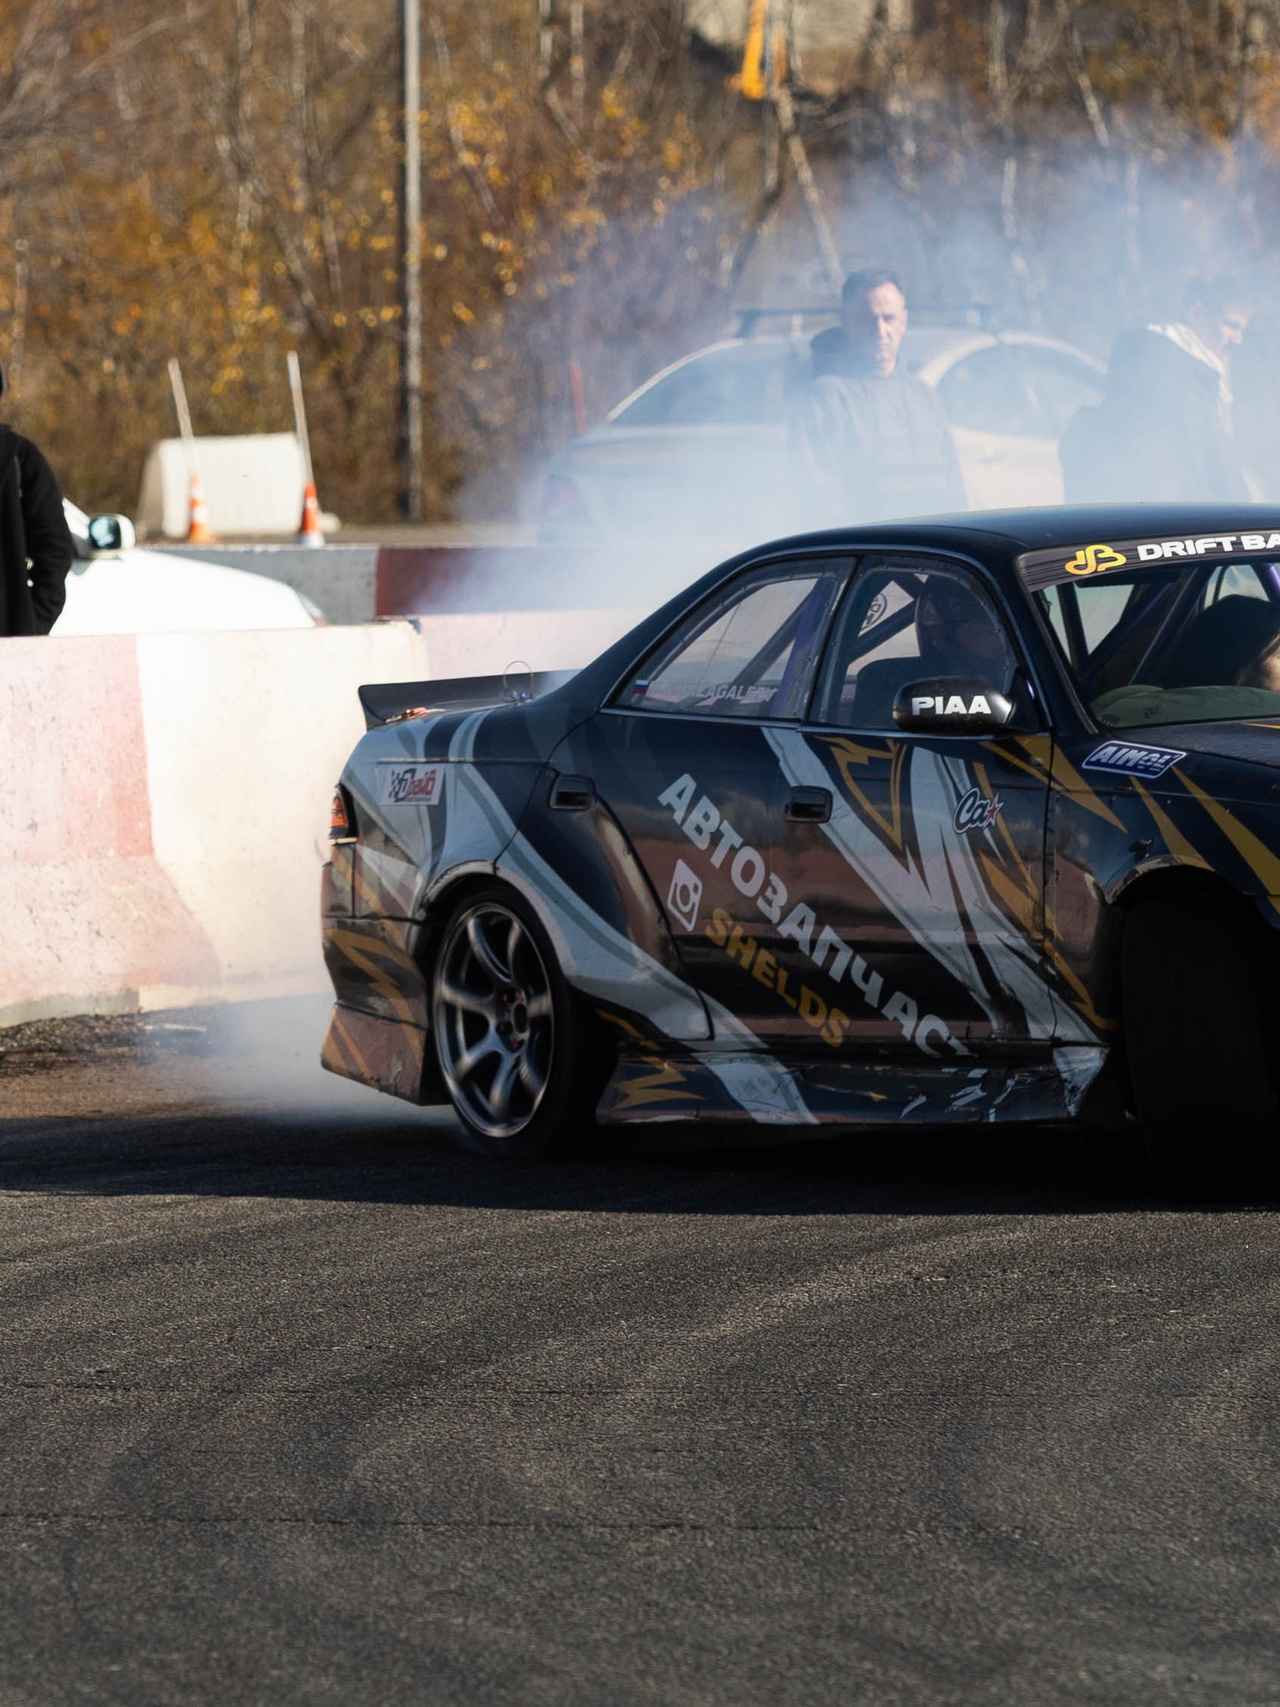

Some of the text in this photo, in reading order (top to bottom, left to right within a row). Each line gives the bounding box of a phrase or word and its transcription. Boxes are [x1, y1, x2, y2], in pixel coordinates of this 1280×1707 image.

[1137, 536, 1237, 561] DRIFT
[911, 695, 992, 716] PIAA
[704, 907, 851, 1048] SHELDS
